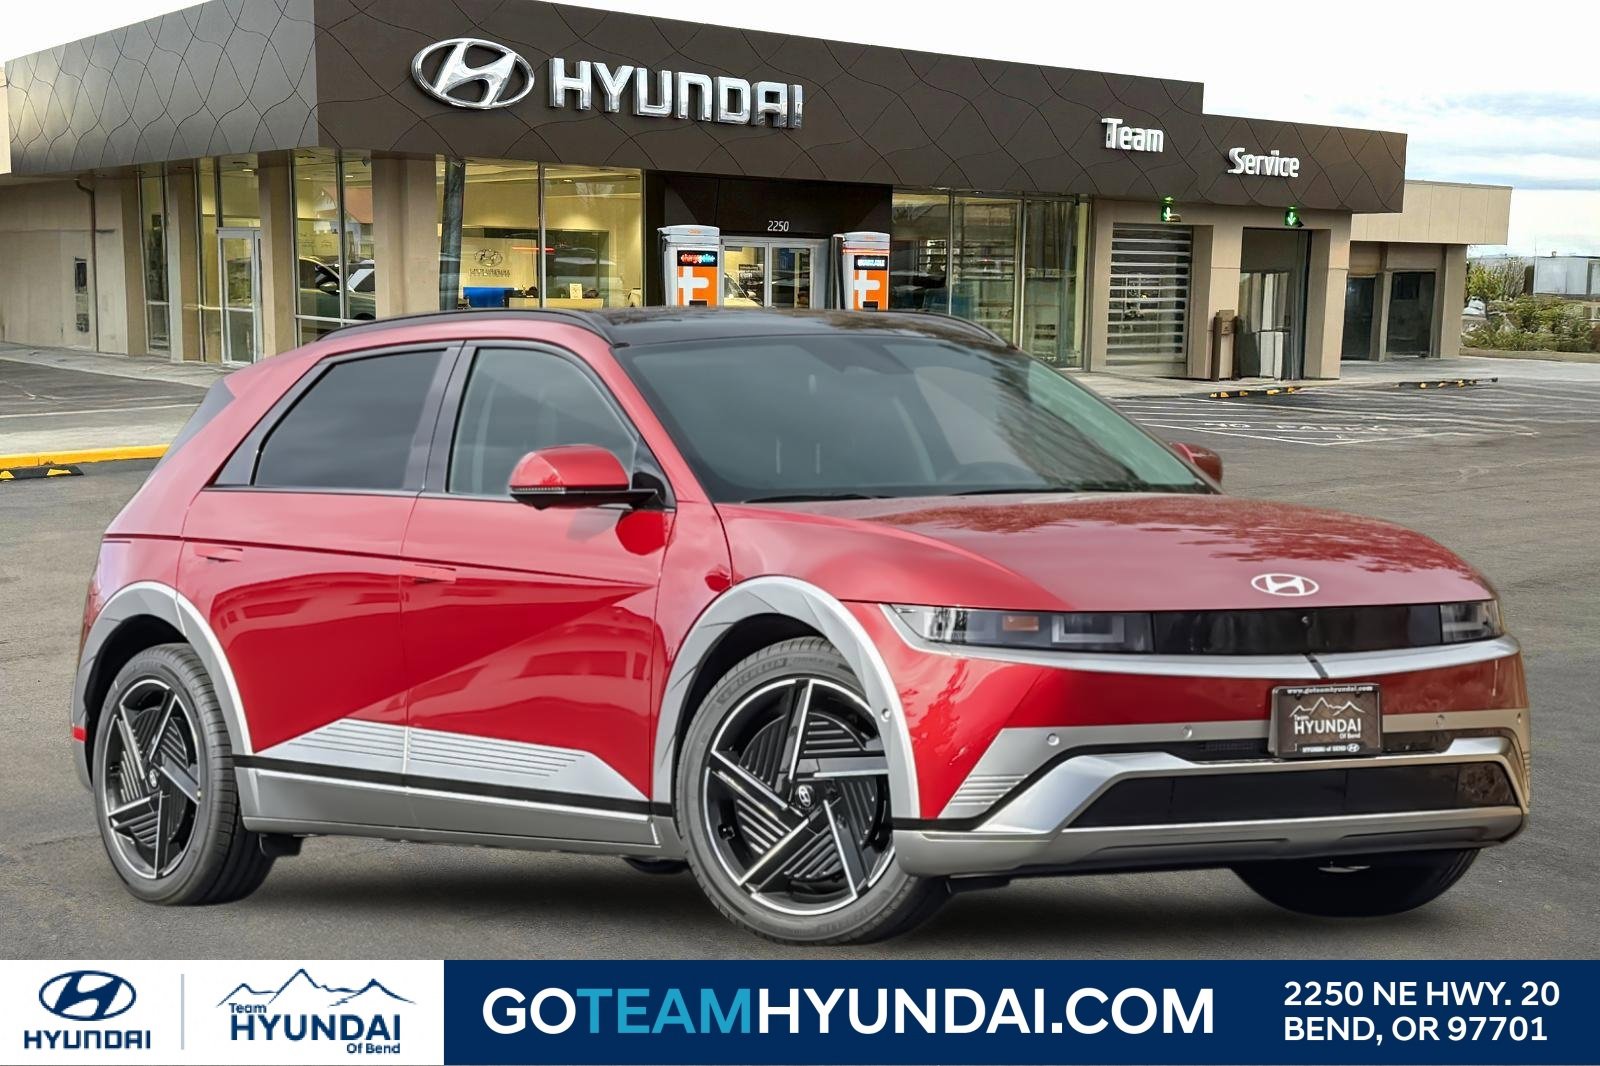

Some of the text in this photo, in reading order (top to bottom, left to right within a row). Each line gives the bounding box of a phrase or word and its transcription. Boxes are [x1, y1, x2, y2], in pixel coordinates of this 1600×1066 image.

[549, 57, 803, 129] HYUNDAI
[1101, 118, 1164, 153] Team
[1227, 147, 1300, 178] Service
[767, 220, 790, 232] 2250
[1294, 718, 1361, 735] HYUNDAI
